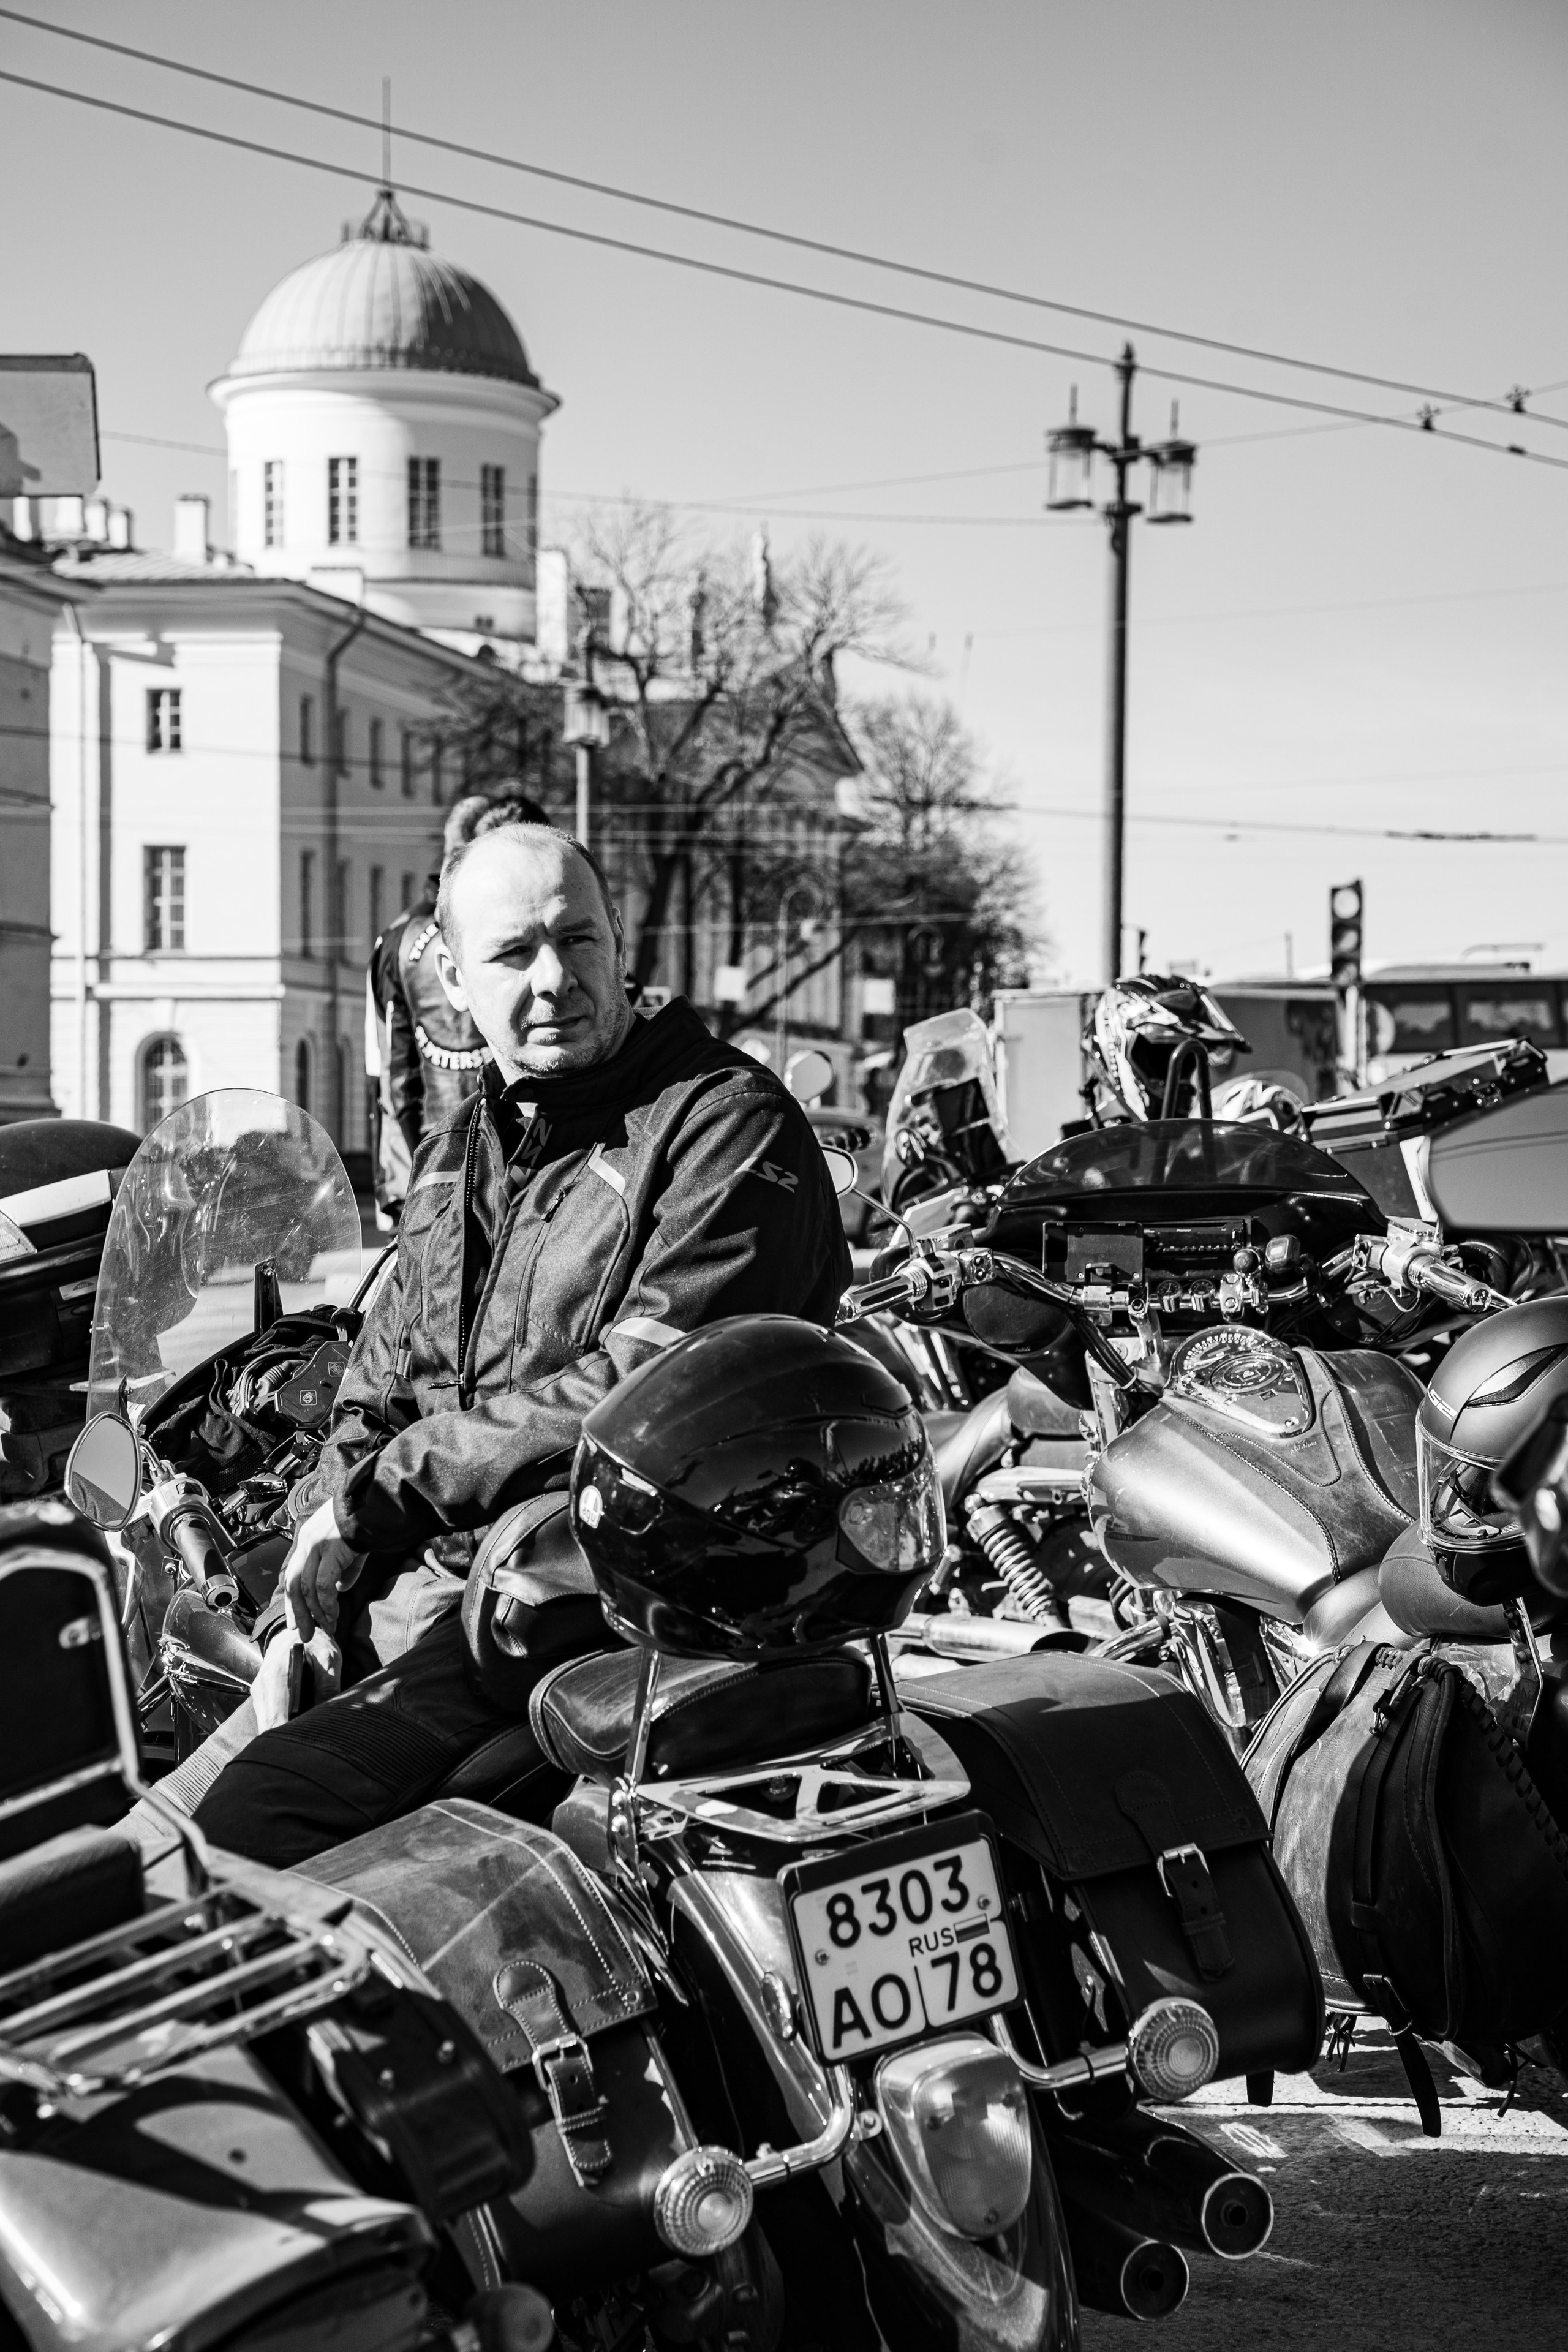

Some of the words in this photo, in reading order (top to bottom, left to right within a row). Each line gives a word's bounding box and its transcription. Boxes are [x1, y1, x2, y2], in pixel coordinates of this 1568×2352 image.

[826, 1855, 970, 1948] 8303
[909, 1927, 954, 1958] RUS
[930, 1943, 1003, 2012] 78
